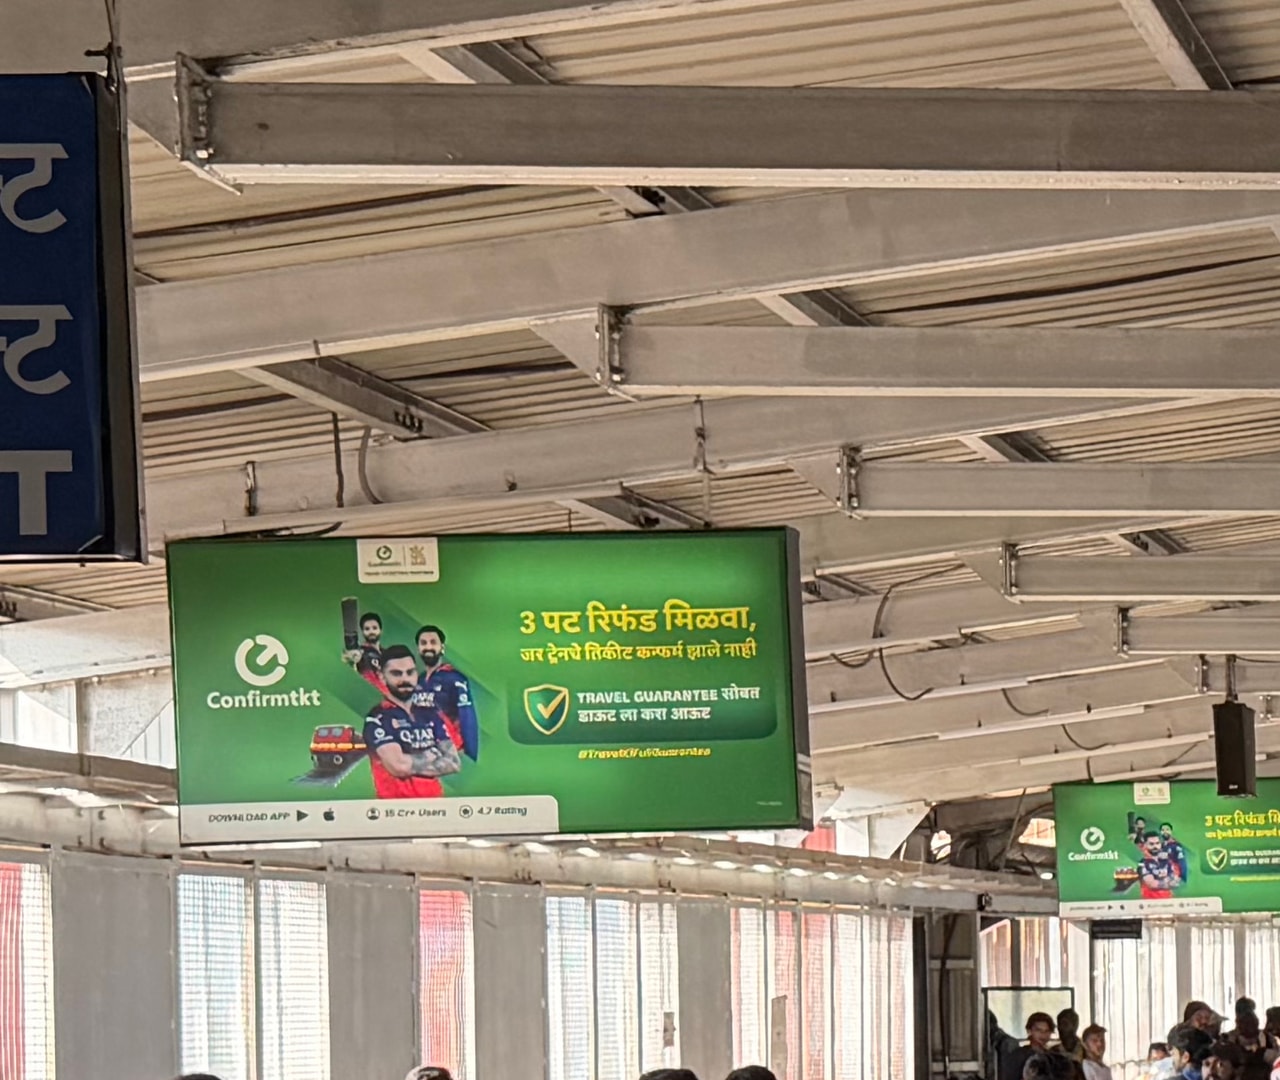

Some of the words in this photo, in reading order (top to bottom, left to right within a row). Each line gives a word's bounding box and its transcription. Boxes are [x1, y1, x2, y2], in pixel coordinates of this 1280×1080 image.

[520, 611, 536, 634] 3
[541, 610, 581, 633] पट
[587, 600, 658, 633] रिफंड
[663, 599, 757, 632] मिळवा,
[724, 637, 757, 658] नाही
[207, 688, 321, 709] Confirmtkt
[576, 691, 630, 704] TRAVEL
[634, 689, 718, 703] GUARANTEE
[419, 807, 447, 817] Users
